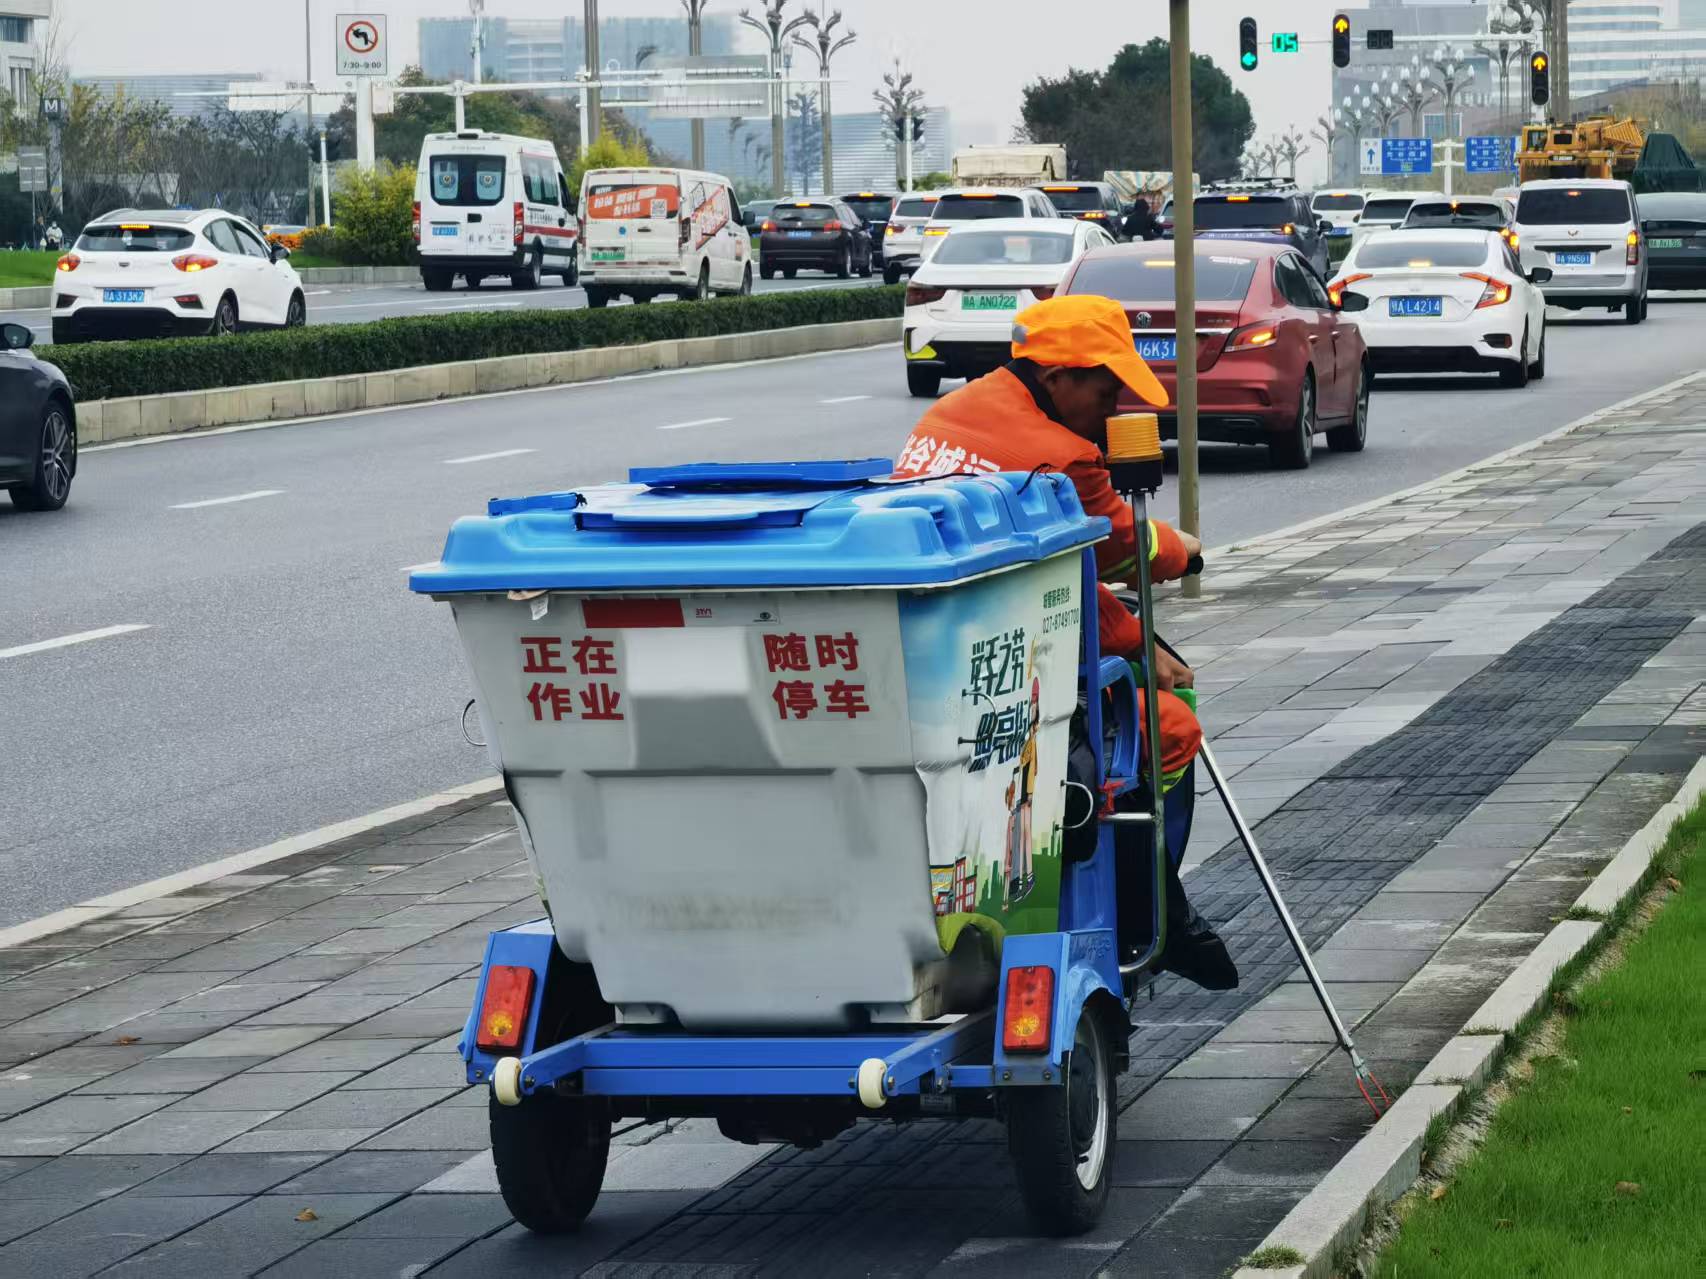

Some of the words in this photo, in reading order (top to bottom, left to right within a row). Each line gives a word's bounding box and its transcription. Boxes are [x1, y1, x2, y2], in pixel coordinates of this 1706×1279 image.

[1271, 32, 1298, 53] 05
[44, 99, 58, 113] M
[1042, 607, 1080, 634] 027-87491700
[520, 635, 618, 675] 正在
[762, 631, 860, 673] 随时
[526, 682, 625, 721] 作业
[771, 679, 871, 721] 停车
